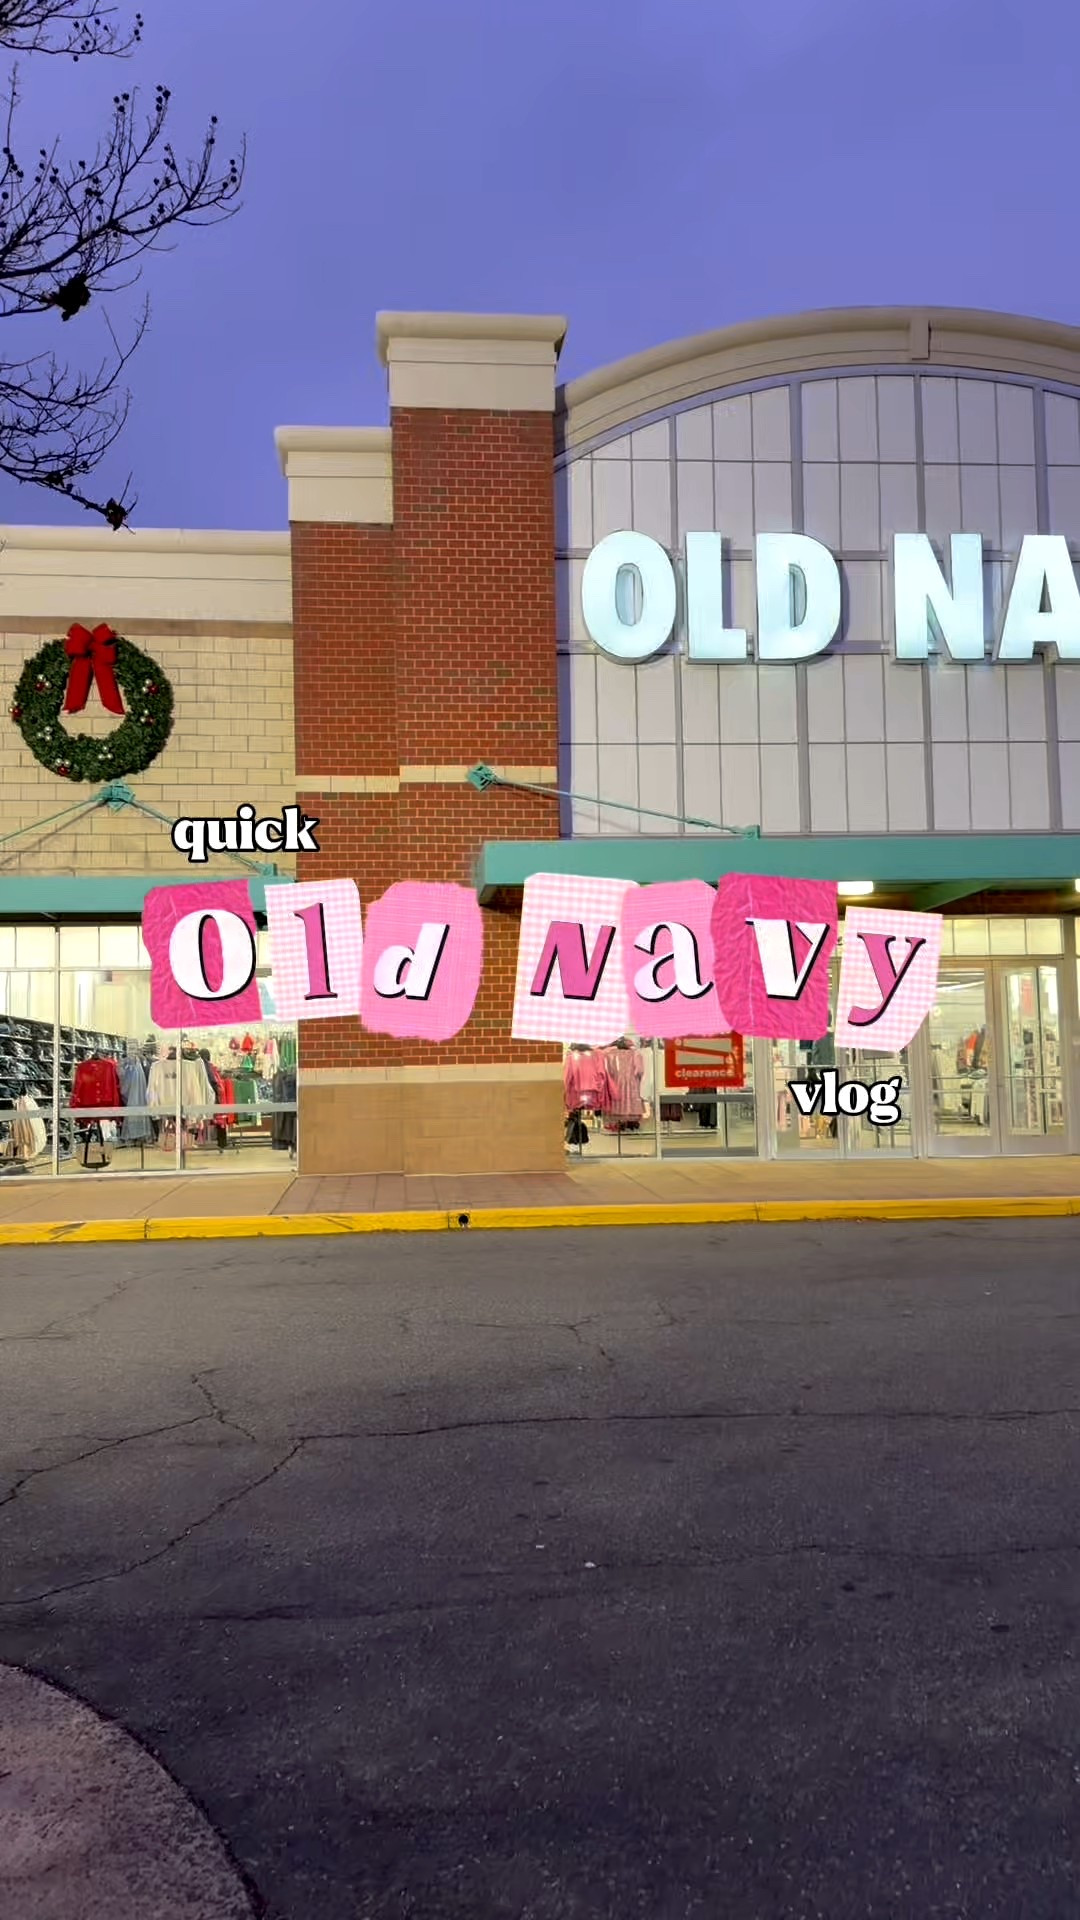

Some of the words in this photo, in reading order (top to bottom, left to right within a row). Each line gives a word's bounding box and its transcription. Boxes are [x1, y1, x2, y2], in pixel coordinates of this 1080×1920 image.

[581, 530, 841, 660] OLD
[893, 532, 1080, 660] NA
[674, 1067, 735, 1079] clearance
